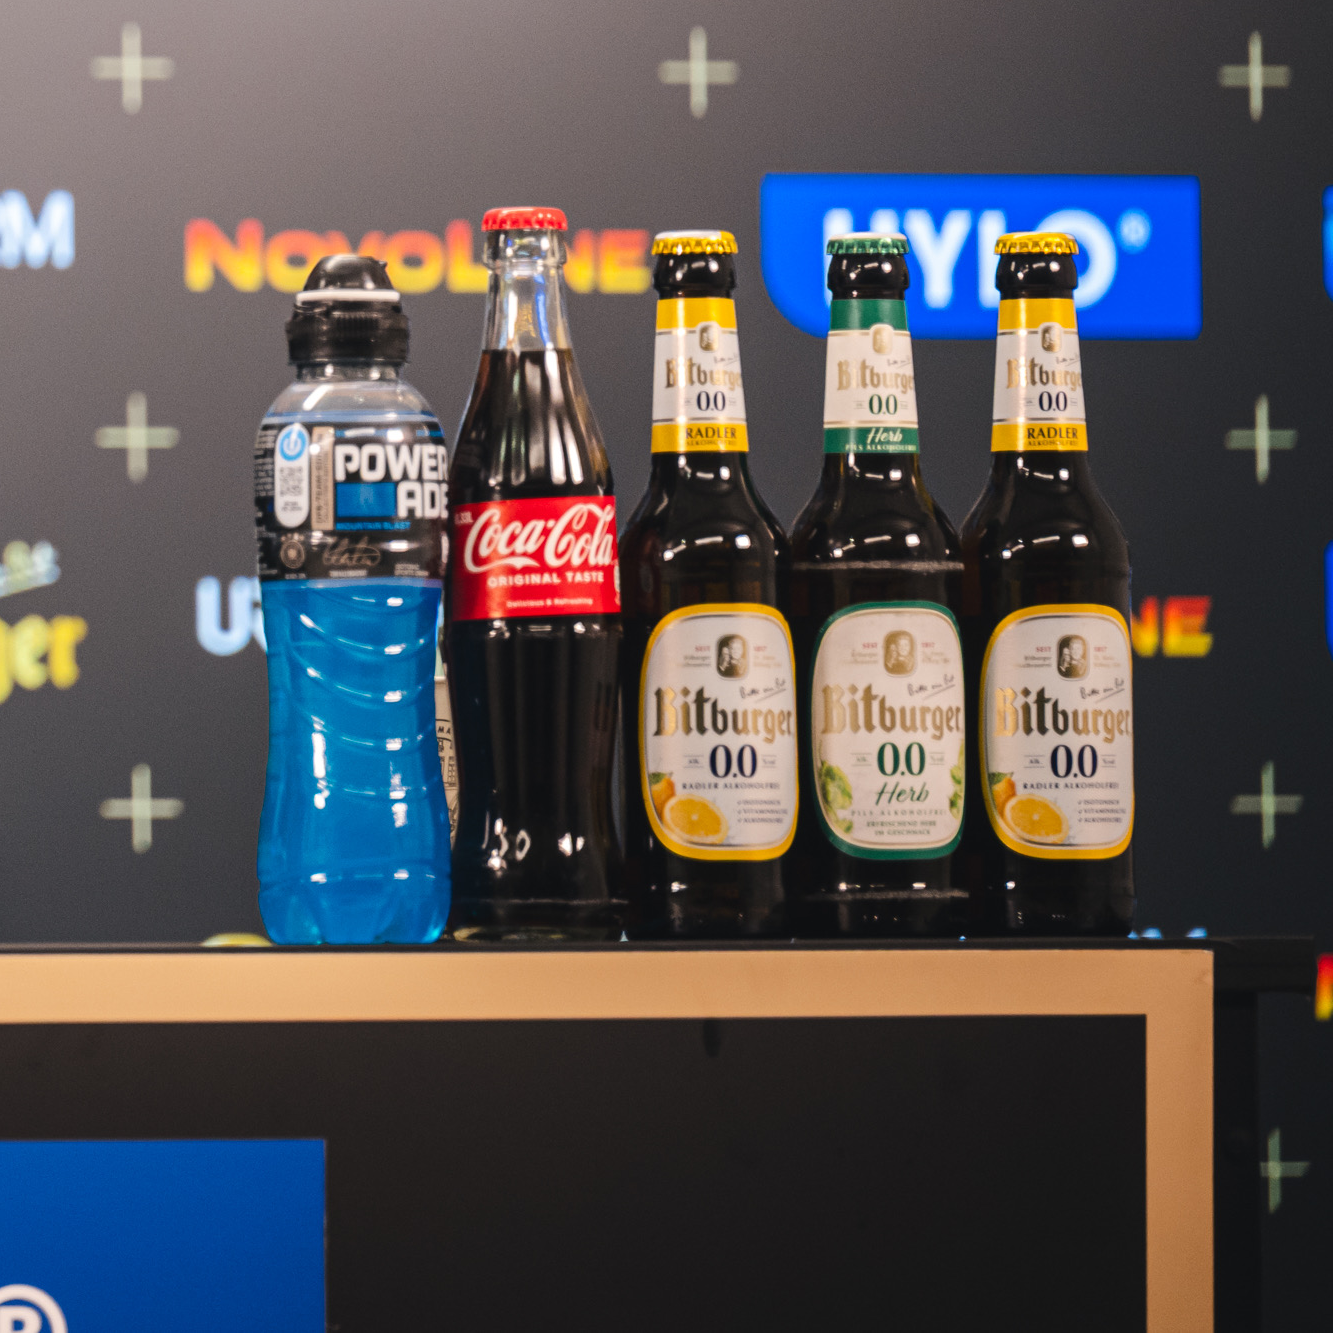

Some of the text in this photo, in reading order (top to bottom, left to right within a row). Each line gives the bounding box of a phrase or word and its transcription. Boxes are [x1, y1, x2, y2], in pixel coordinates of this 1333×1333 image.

[697, 391, 726, 411] 0.0
[869, 394, 898, 415] 0.0
[1039, 391, 1067, 411] 0.0
[686, 427, 737, 439] RADLER
[867, 428, 903, 443] Herb
[1027, 427, 1078, 439] RADLER
[396, 481, 448, 519] ADE
[464, 503, 615, 574] Coca-Cola
[487, 571, 604, 589] ORIGINAL TASTE
[654, 686, 792, 744] Bitburger
[821, 683, 961, 741] Bitburger
[994, 686, 1131, 744] Bitburger
[710, 744, 757, 778] 0.0
[877, 742, 925, 776] 0.0
[1051, 744, 1097, 778] 0.0
[875, 781, 929, 806] Herb
